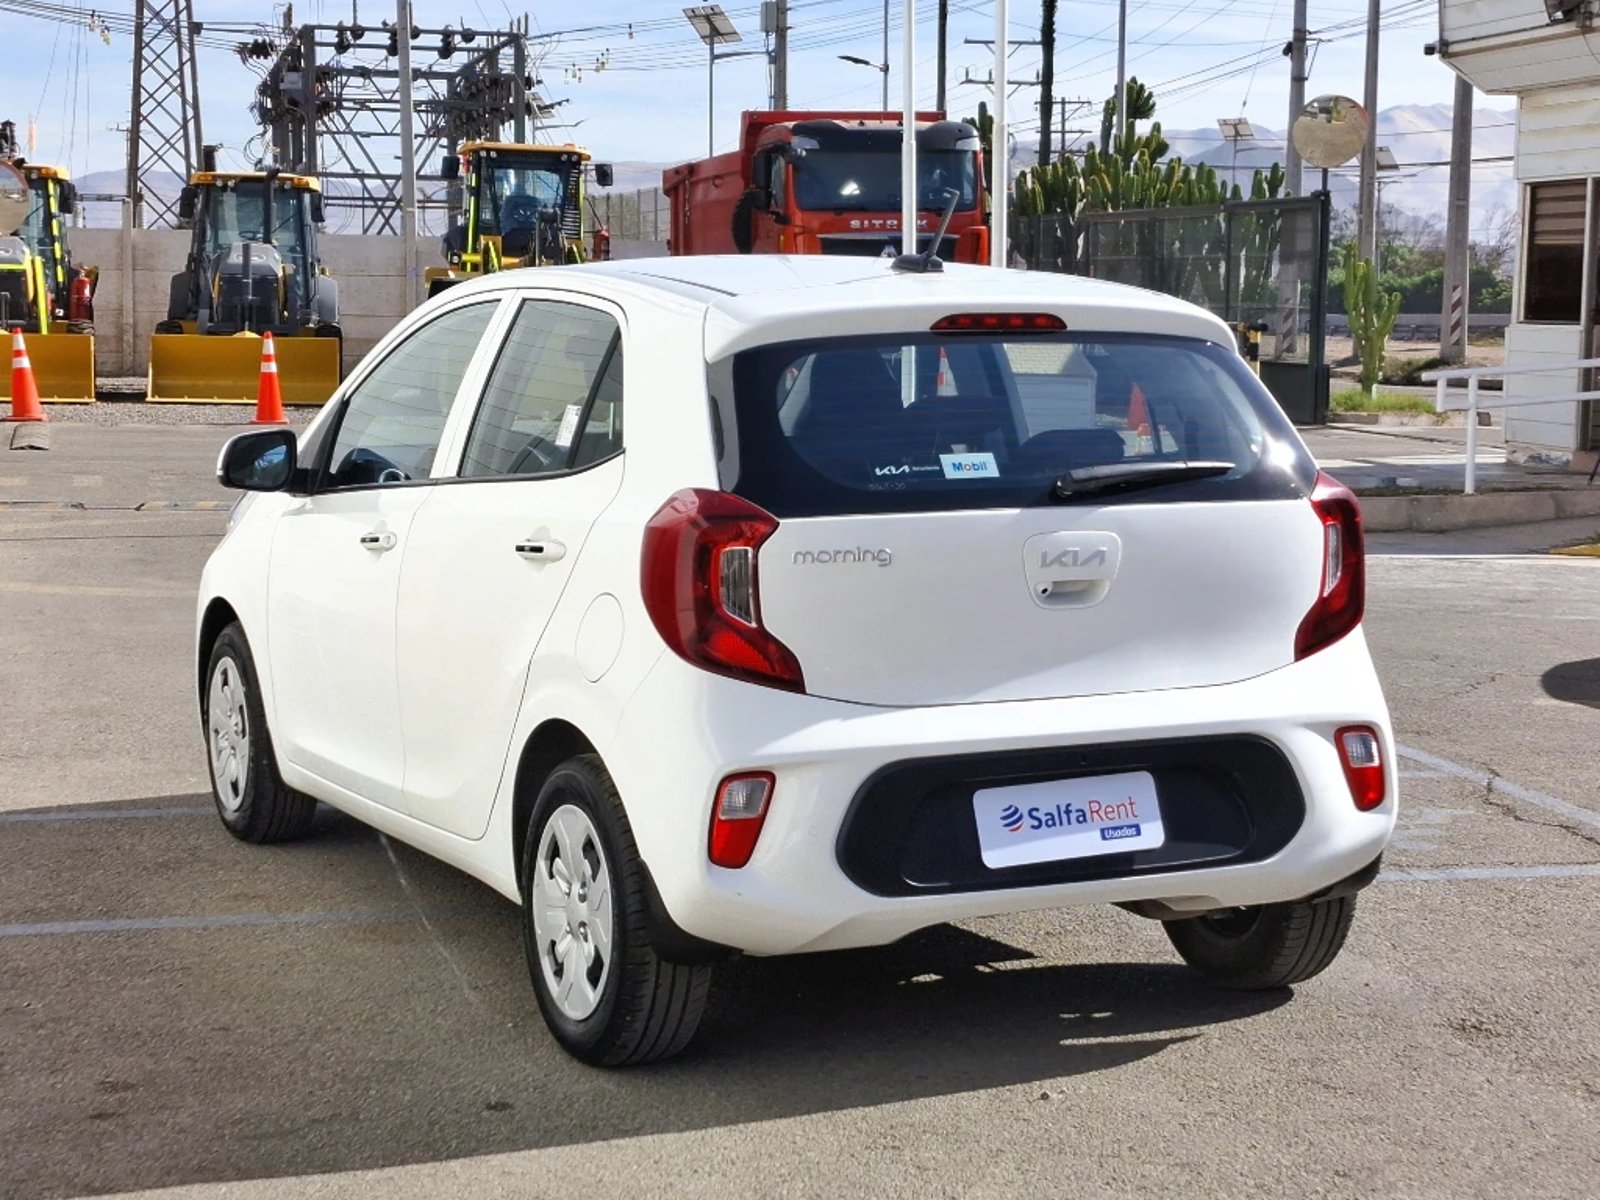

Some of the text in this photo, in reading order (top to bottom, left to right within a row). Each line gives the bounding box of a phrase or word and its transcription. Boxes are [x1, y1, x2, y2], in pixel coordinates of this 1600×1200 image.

[850, 219, 928, 229] SITRK
[875, 465, 910, 476] KIA
[951, 461, 988, 472] Mobil
[792, 547, 892, 567] morning
[1039, 548, 1107, 568] KIA
[1027, 796, 1138, 830] SalfaRent
[1103, 825, 1137, 839] Usados
